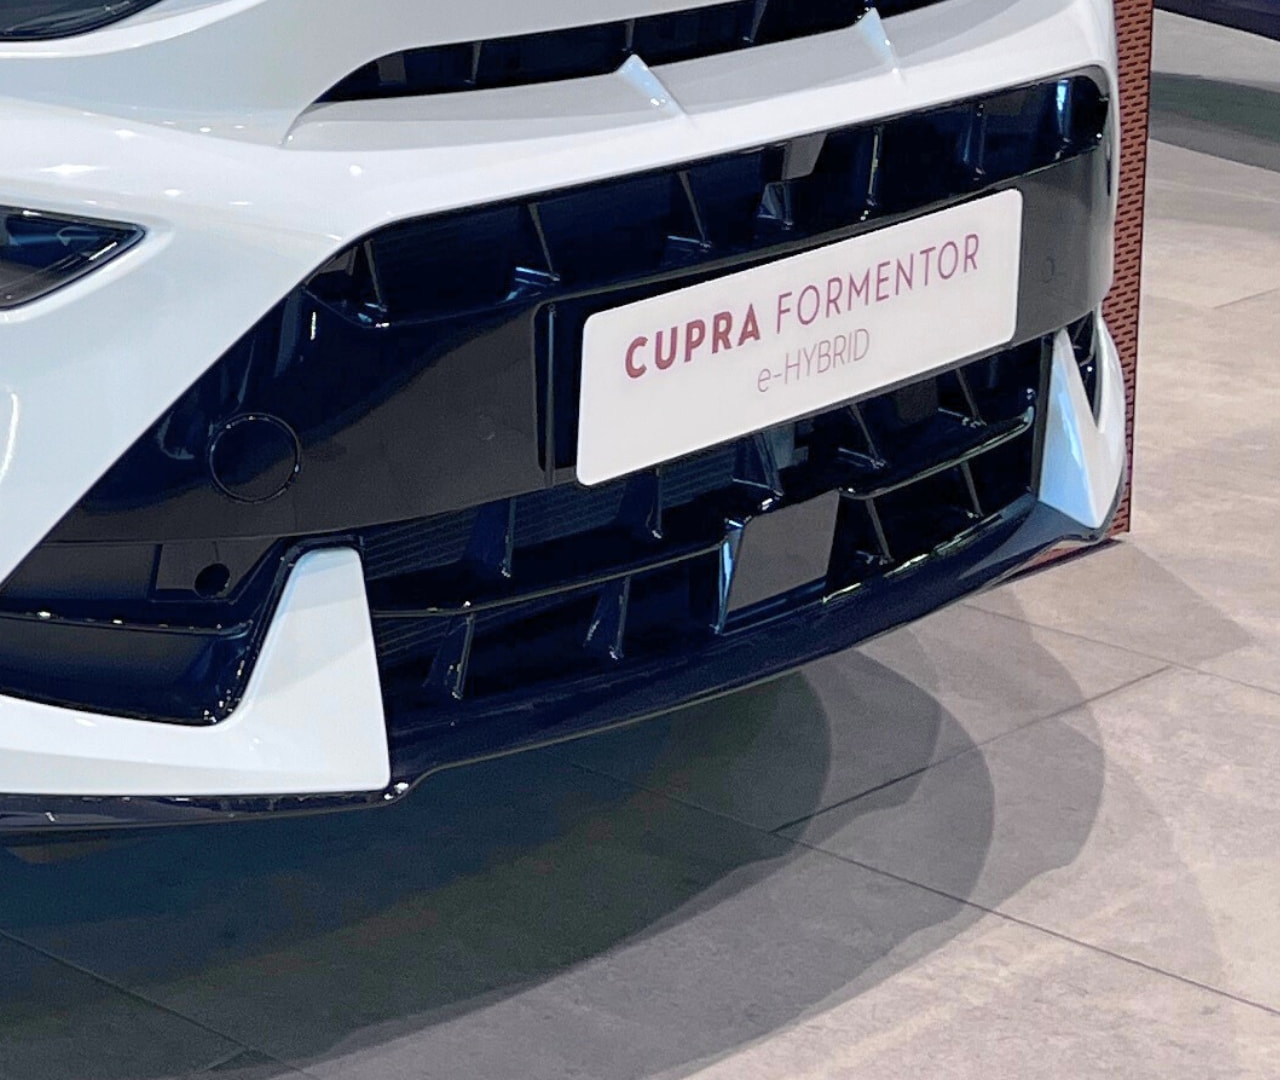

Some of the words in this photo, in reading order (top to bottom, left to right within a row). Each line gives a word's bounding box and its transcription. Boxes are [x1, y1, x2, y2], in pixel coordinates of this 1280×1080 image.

[623, 302, 761, 379] CUPRA
[776, 232, 980, 335] FORMENTOR
[755, 327, 871, 393] e-HYBRID
